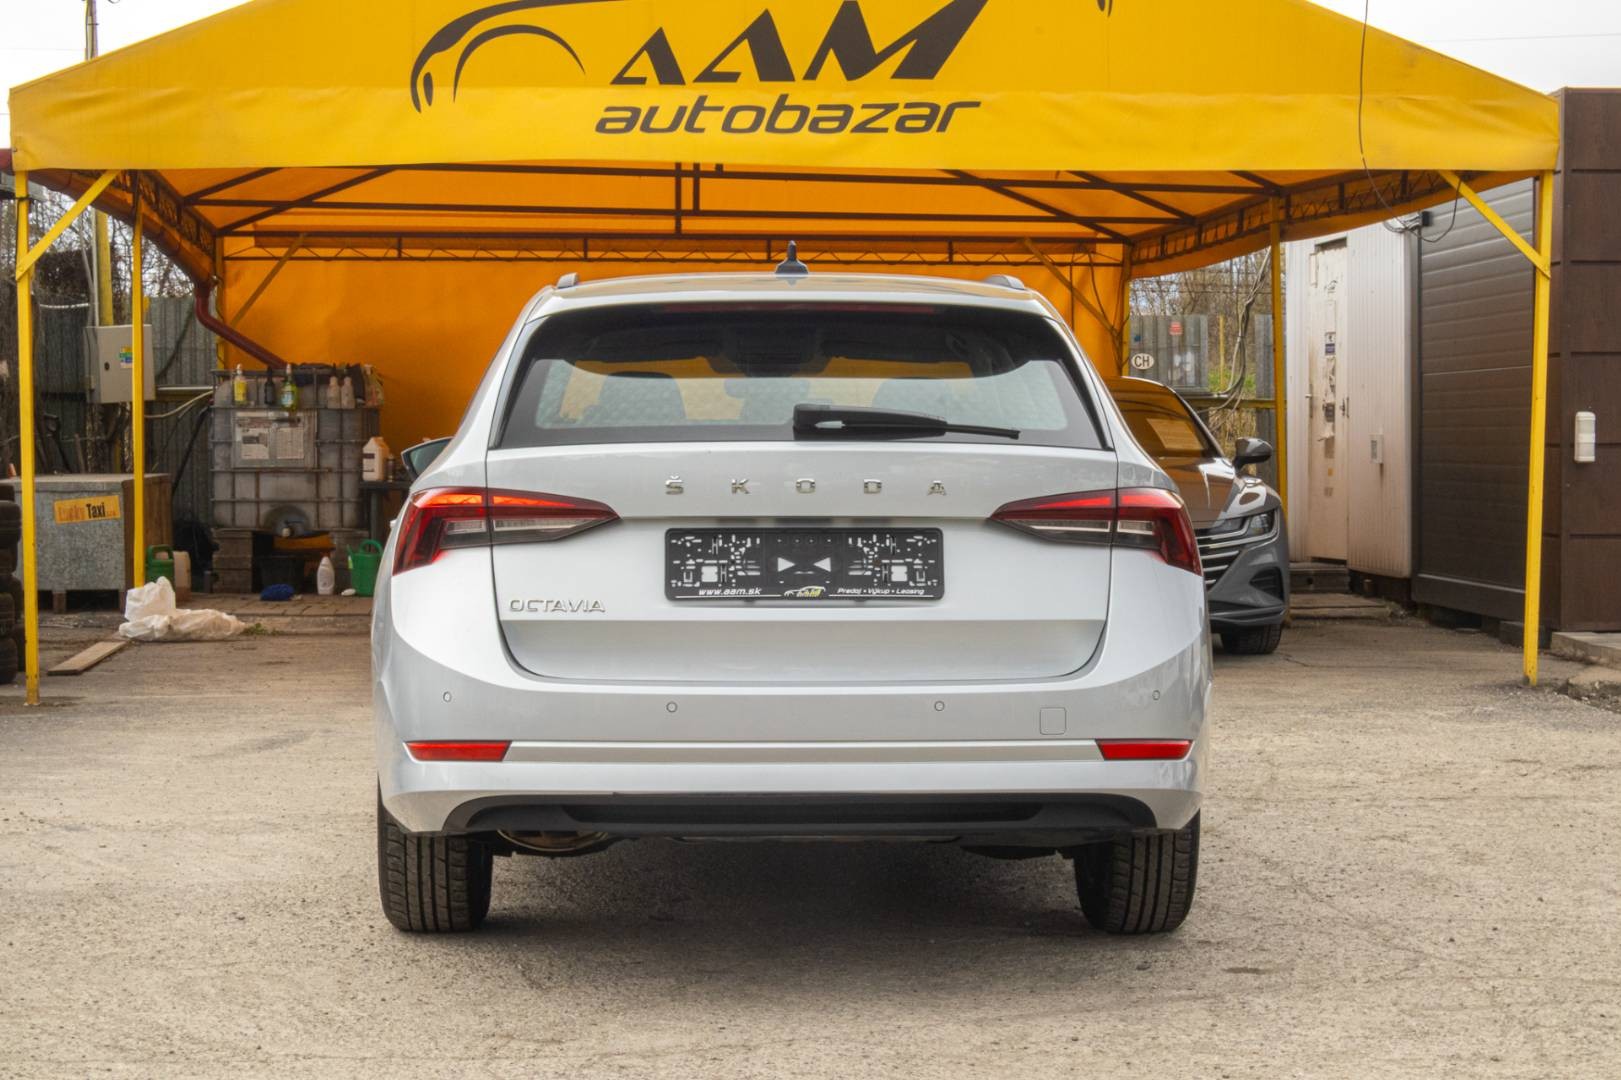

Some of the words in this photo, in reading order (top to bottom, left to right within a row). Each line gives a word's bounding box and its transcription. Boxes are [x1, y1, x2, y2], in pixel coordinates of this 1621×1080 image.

[610, 0, 988, 86] AAM
[594, 93, 981, 135] autobazar
[1134, 355, 1150, 368] CH
[665, 475, 947, 496] ŠKODA
[86, 502, 106, 519] Taxi
[698, 586, 762, 596] www.aam.sk
[510, 599, 606, 612] OCTAVIA
